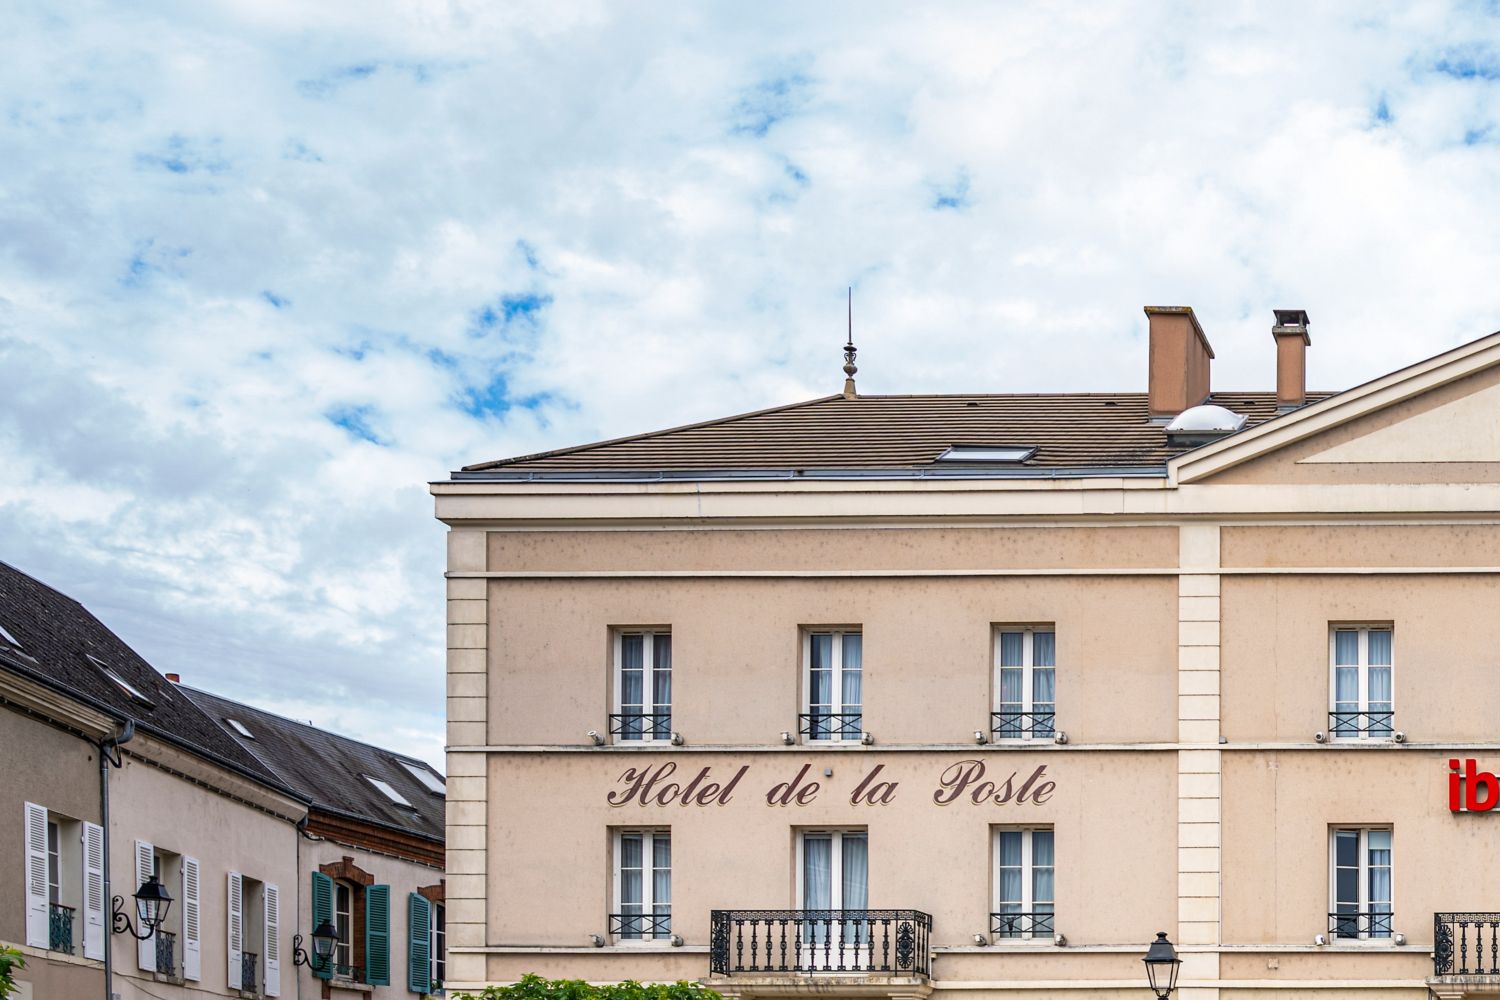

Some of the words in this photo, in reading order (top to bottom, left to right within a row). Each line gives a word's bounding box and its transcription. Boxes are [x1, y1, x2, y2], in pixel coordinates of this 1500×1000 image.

[765, 763, 821, 808] de
[849, 764, 900, 807] la
[932, 758, 1057, 807] Poste
